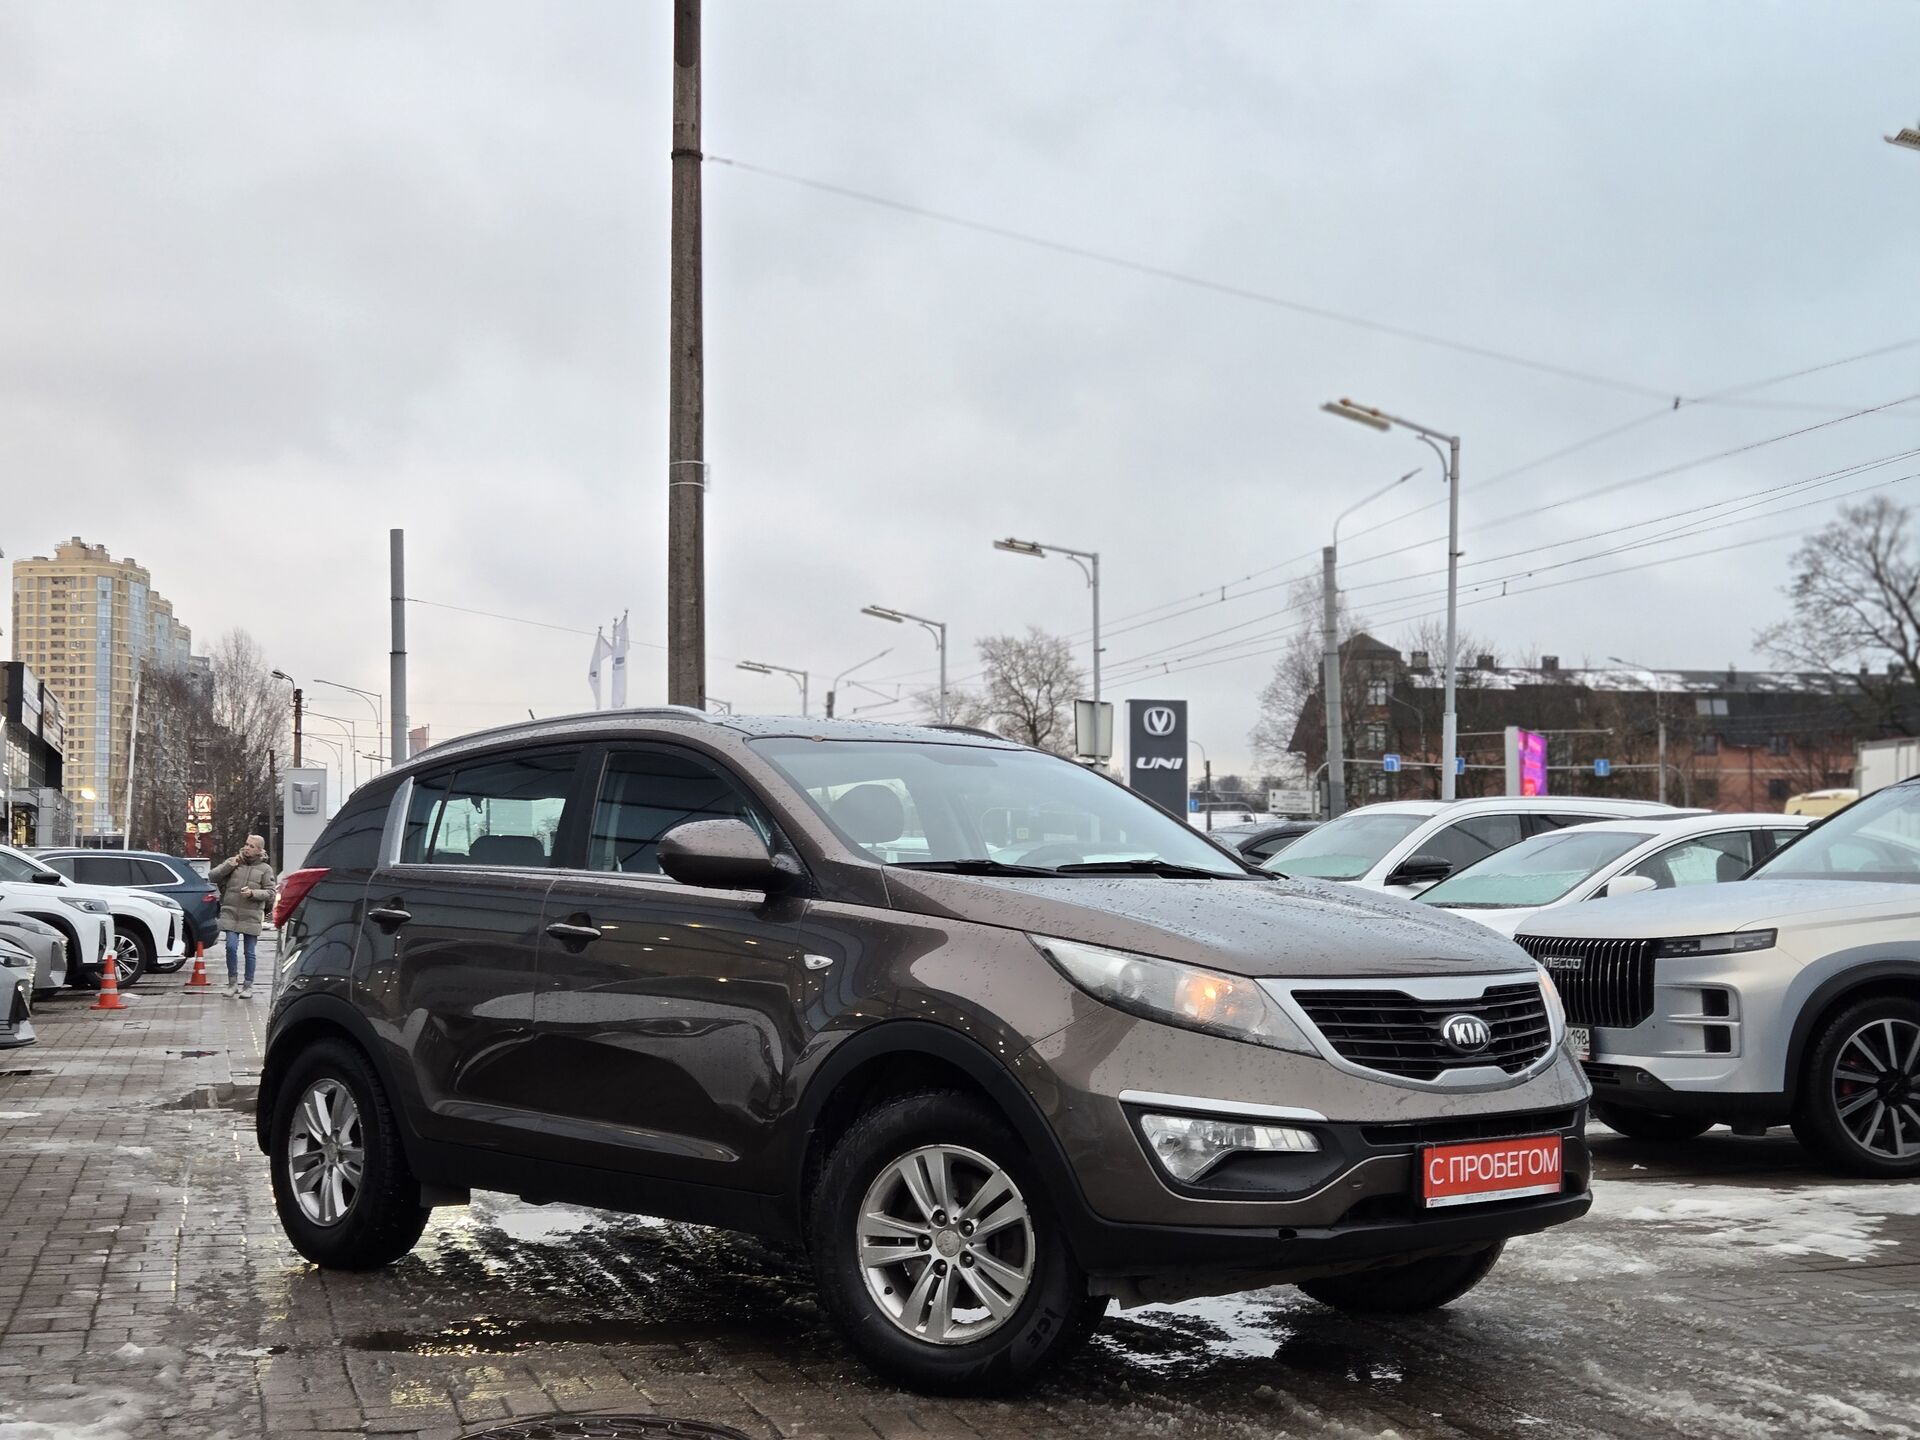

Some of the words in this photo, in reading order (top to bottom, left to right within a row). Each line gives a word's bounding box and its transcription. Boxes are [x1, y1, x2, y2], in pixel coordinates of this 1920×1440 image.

[1135, 756, 1184, 770] UNI
[1451, 1022, 1487, 1045] KIA
[1570, 1029, 1587, 1045] 198
[1429, 1157, 1445, 1185] С
[1449, 1146, 1559, 1183] ПРОБЕГОМ
